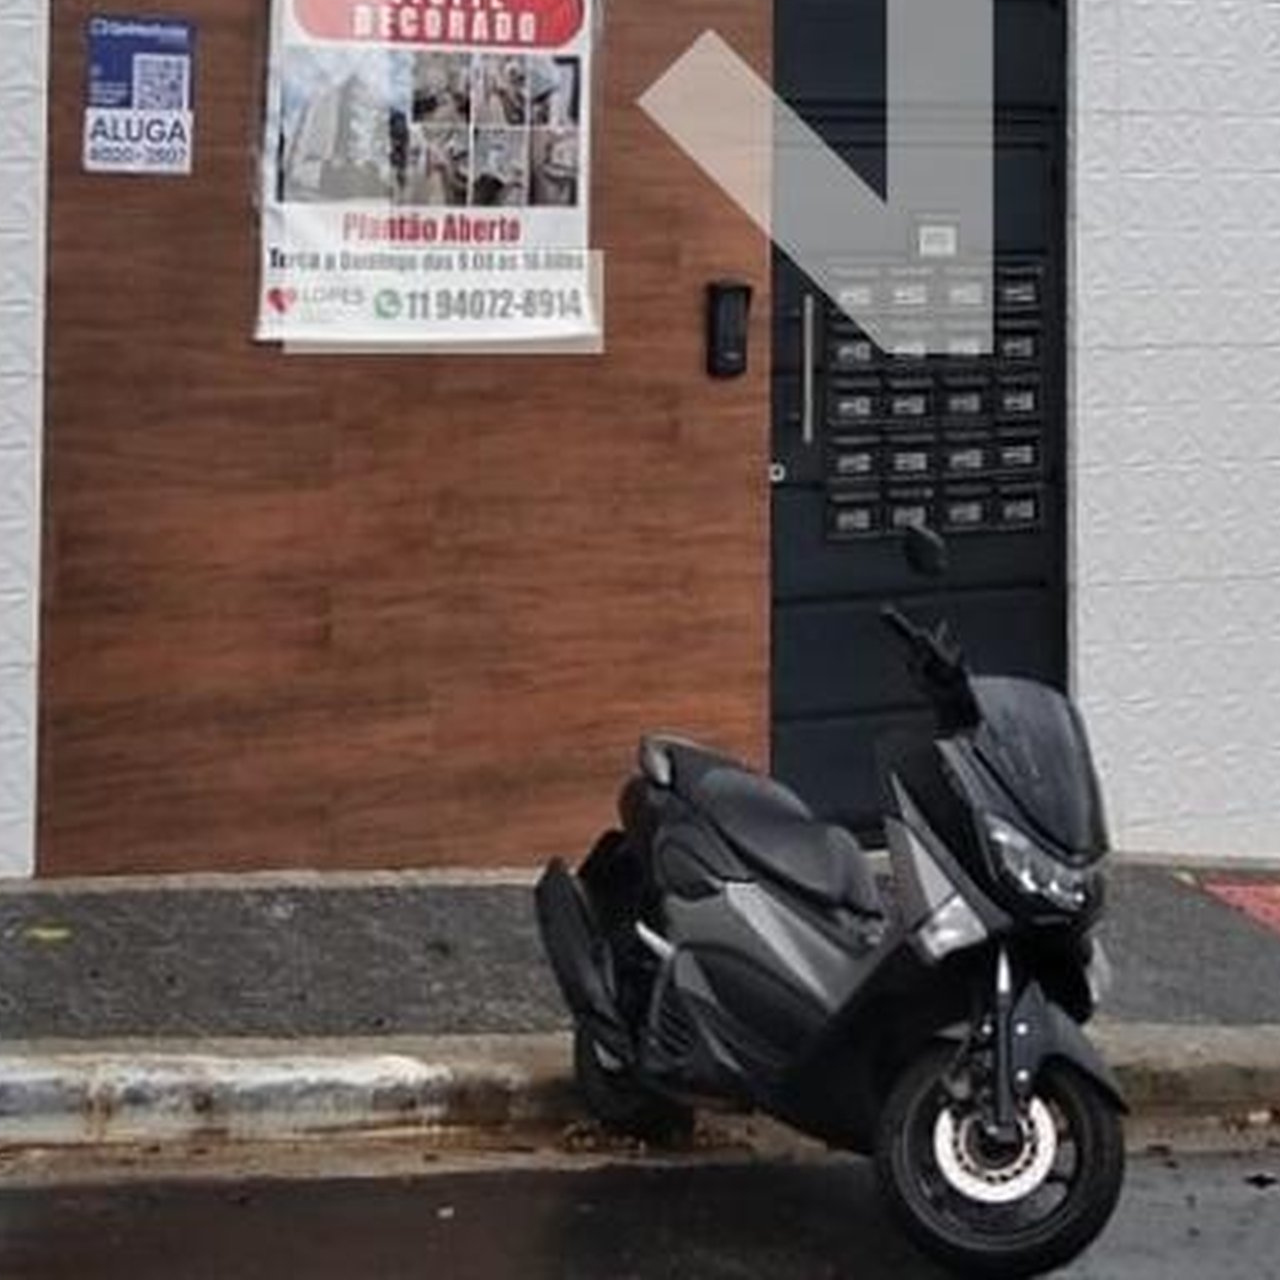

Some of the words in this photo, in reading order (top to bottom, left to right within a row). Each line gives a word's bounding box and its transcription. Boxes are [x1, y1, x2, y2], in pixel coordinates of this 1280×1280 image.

[353, 5, 536, 43] DECORADO
[89, 117, 188, 144] ALUGA
[342, 211, 436, 242] Plantão
[442, 212, 522, 244] Aberto
[407, 291, 430, 320] 11
[435, 289, 583, 320] 94072-8914
